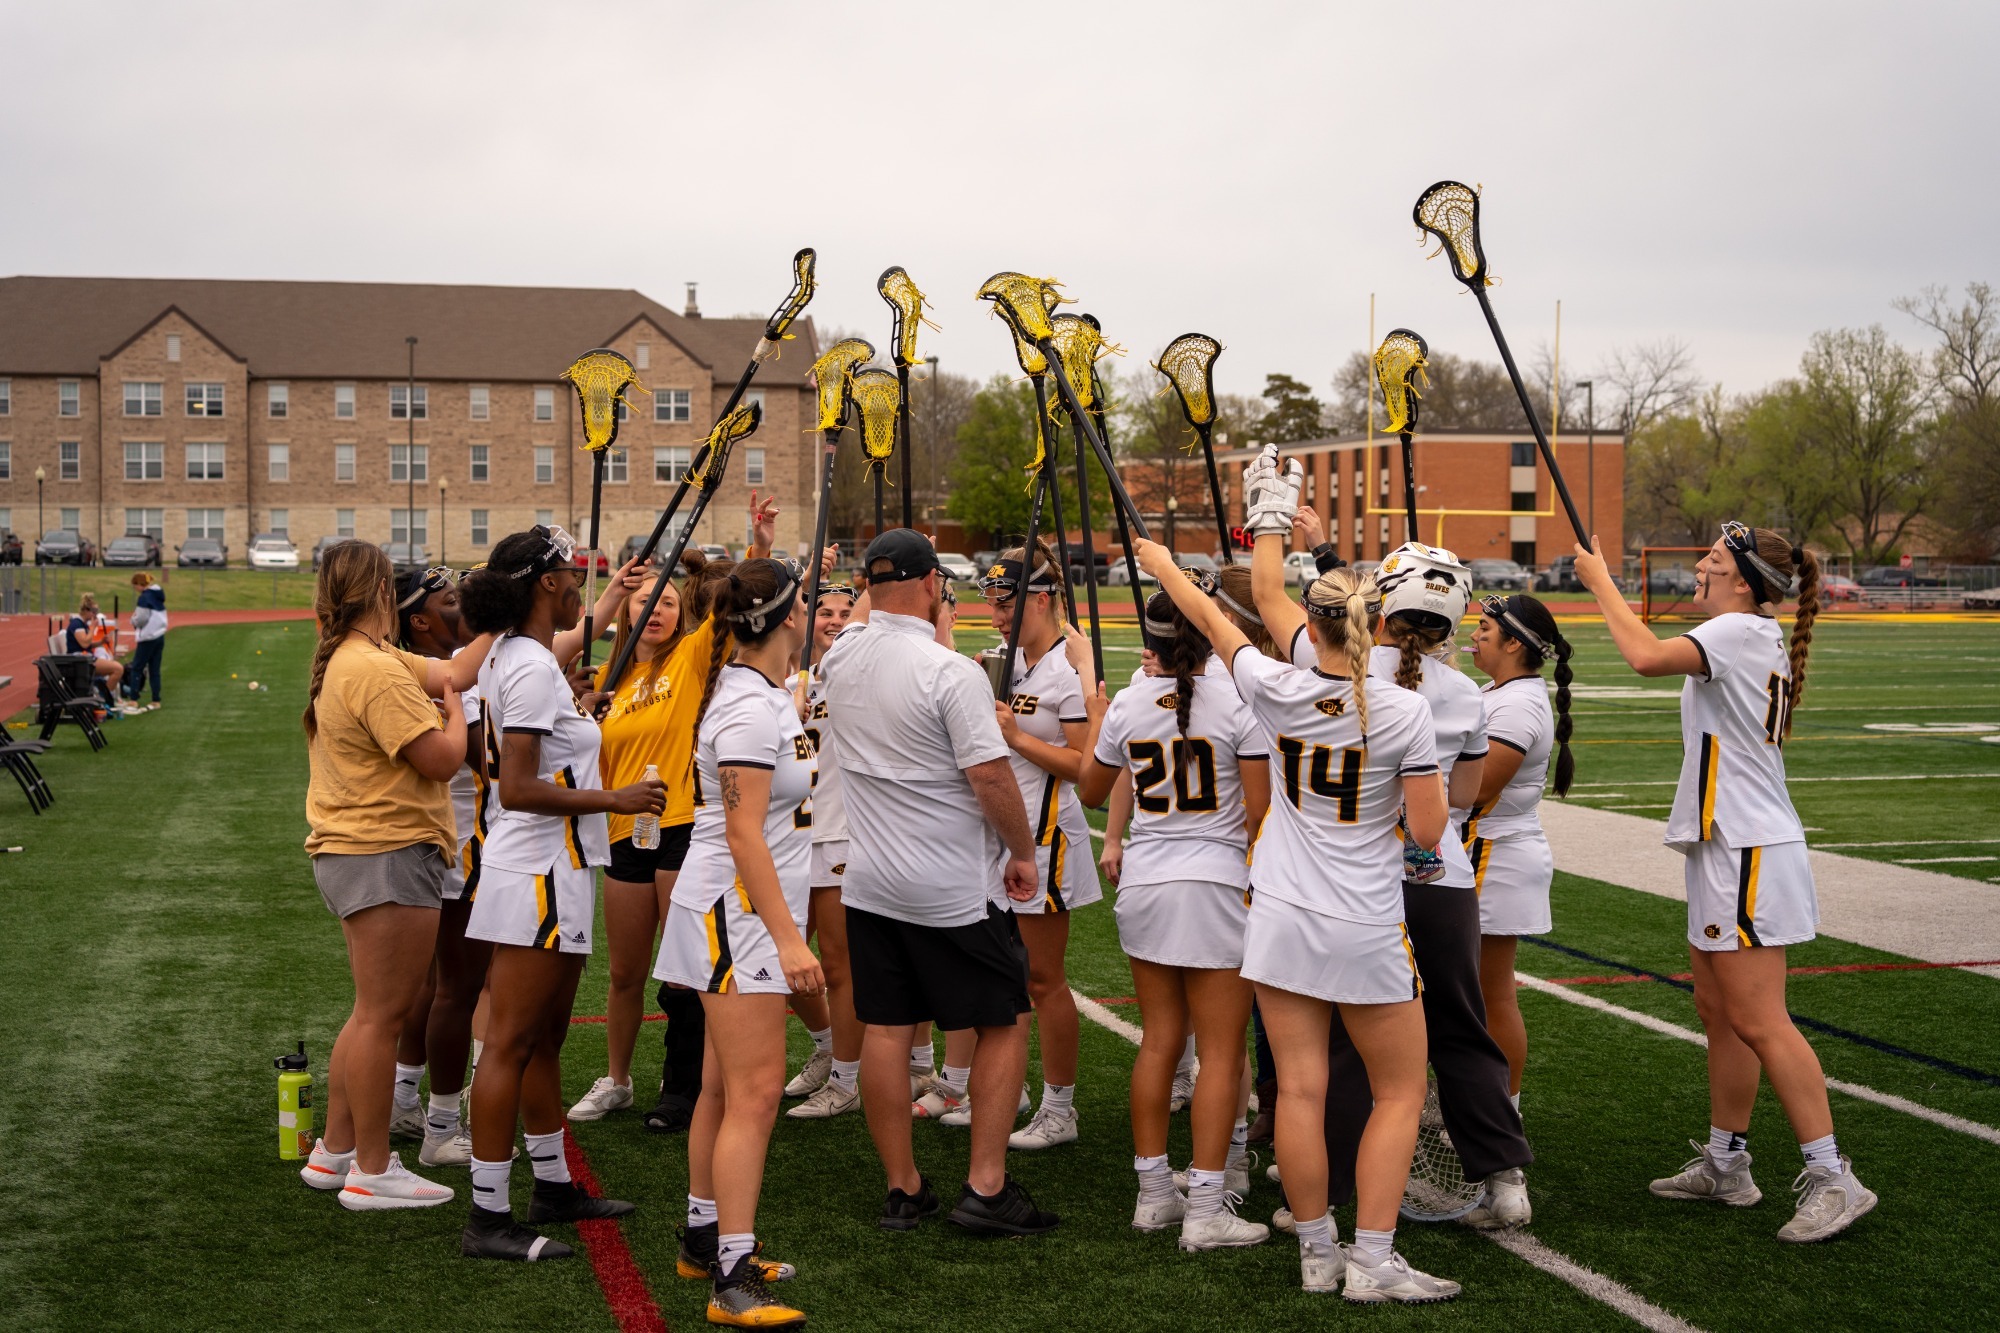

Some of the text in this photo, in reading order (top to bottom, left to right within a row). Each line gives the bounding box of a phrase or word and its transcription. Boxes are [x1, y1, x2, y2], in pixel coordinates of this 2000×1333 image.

[1425, 582, 1450, 594] BRAVES
[1308, 603, 1324, 615] STX
[1330, 609, 1346, 617] ST
[1162, 696, 1175, 708] OU
[1323, 701, 1338, 714] OU
[1127, 736, 1219, 816] 20
[1277, 732, 1364, 824] 14
